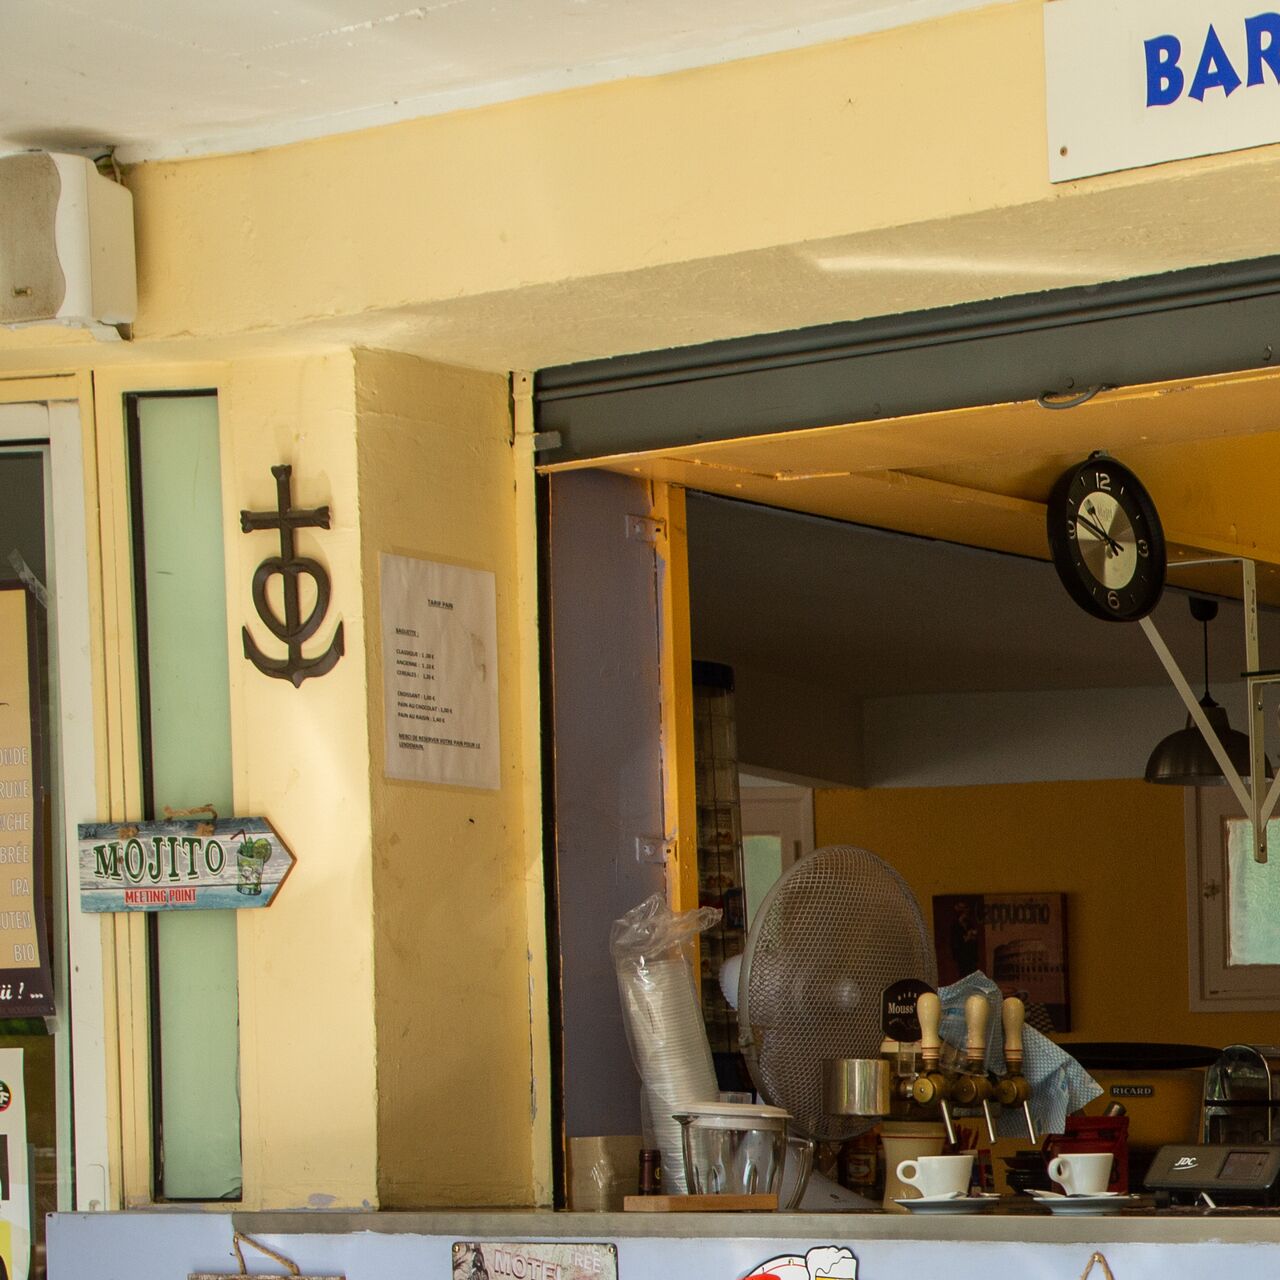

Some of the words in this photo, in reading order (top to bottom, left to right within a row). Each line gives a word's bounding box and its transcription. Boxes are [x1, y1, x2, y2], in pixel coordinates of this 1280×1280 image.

[1095, 472, 1111, 491] 12
[1107, 591, 1120, 610] 6
[93, 836, 226, 883] MOJITO
[11, 879, 30, 896] IPA
[124, 888, 167, 904] MEETING
[168, 887, 198, 904] POINT
[14, 944, 35, 962] BIO
[1113, 1087, 1152, 1095] RICARD
[1175, 1157, 1197, 1166] JDC
